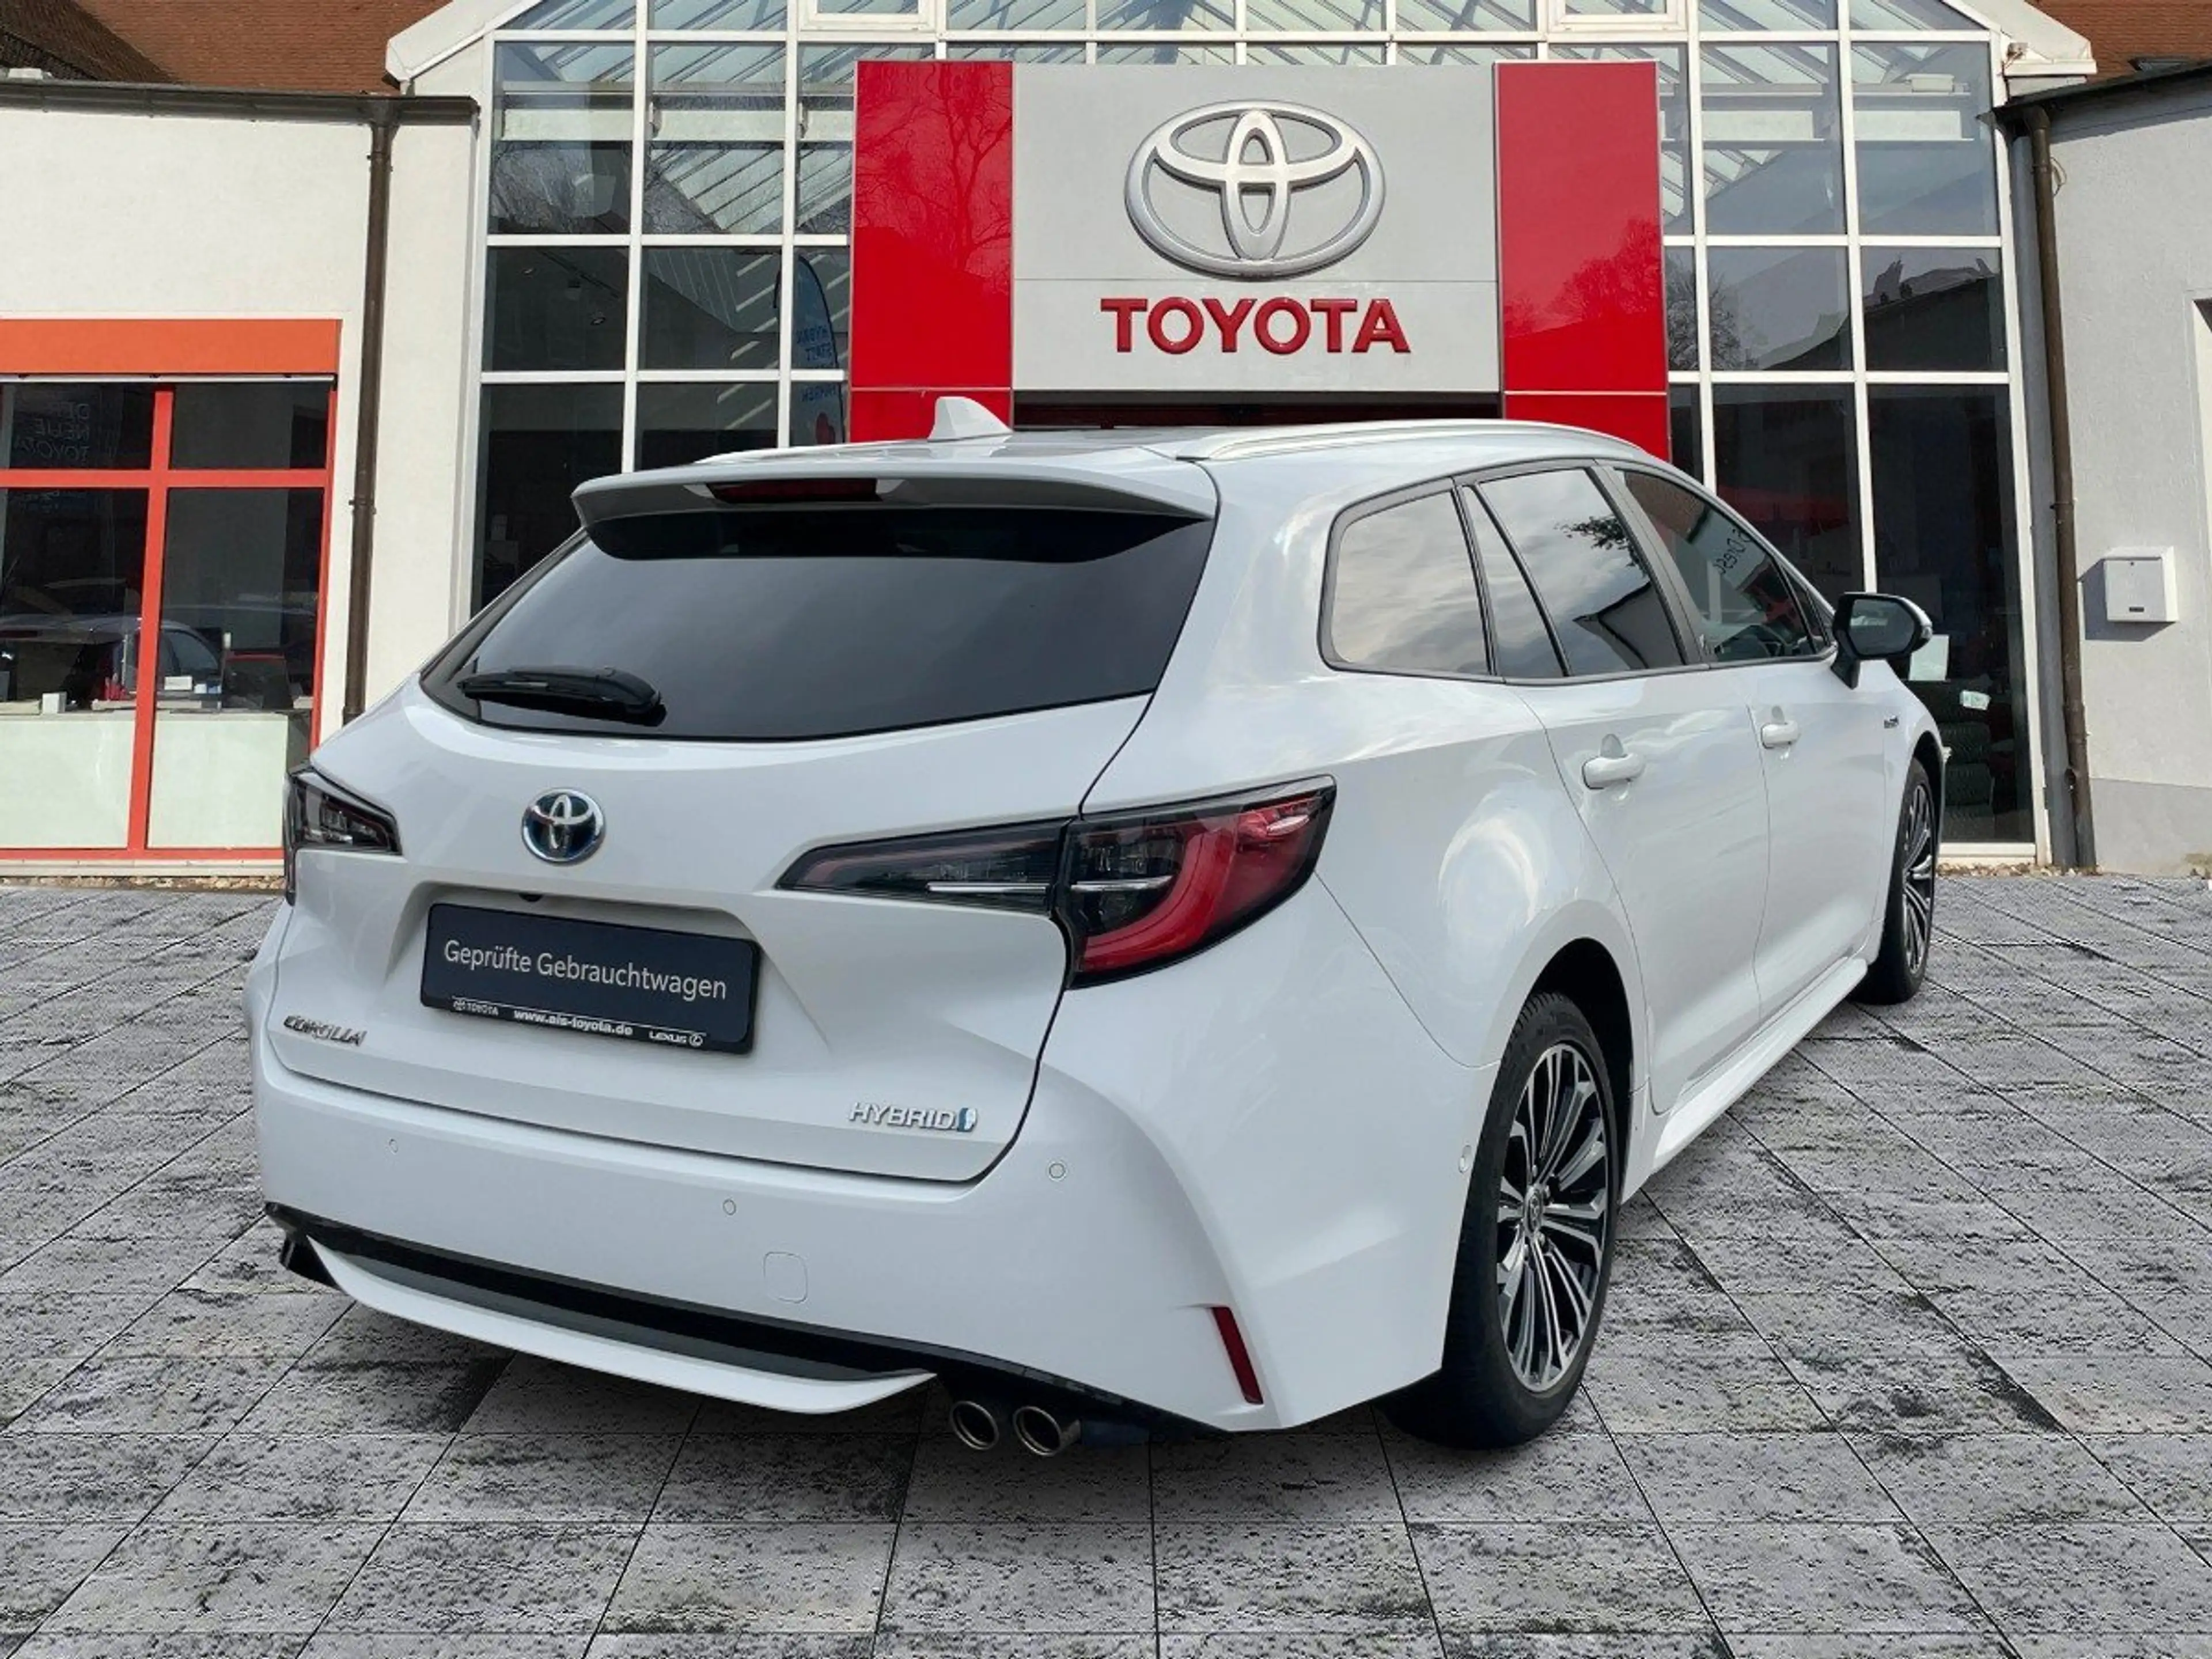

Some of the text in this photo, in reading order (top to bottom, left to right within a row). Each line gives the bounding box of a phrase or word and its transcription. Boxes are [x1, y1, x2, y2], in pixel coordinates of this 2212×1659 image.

[1100, 297, 1411, 354] TOYOTA
[444, 940, 727, 1001] Geprüfte Gebrauchtwagen
[283, 1016, 368, 1047] COROLLA
[649, 1030, 687, 1044] LEXUS
[850, 1101, 956, 1131] HYBRID
